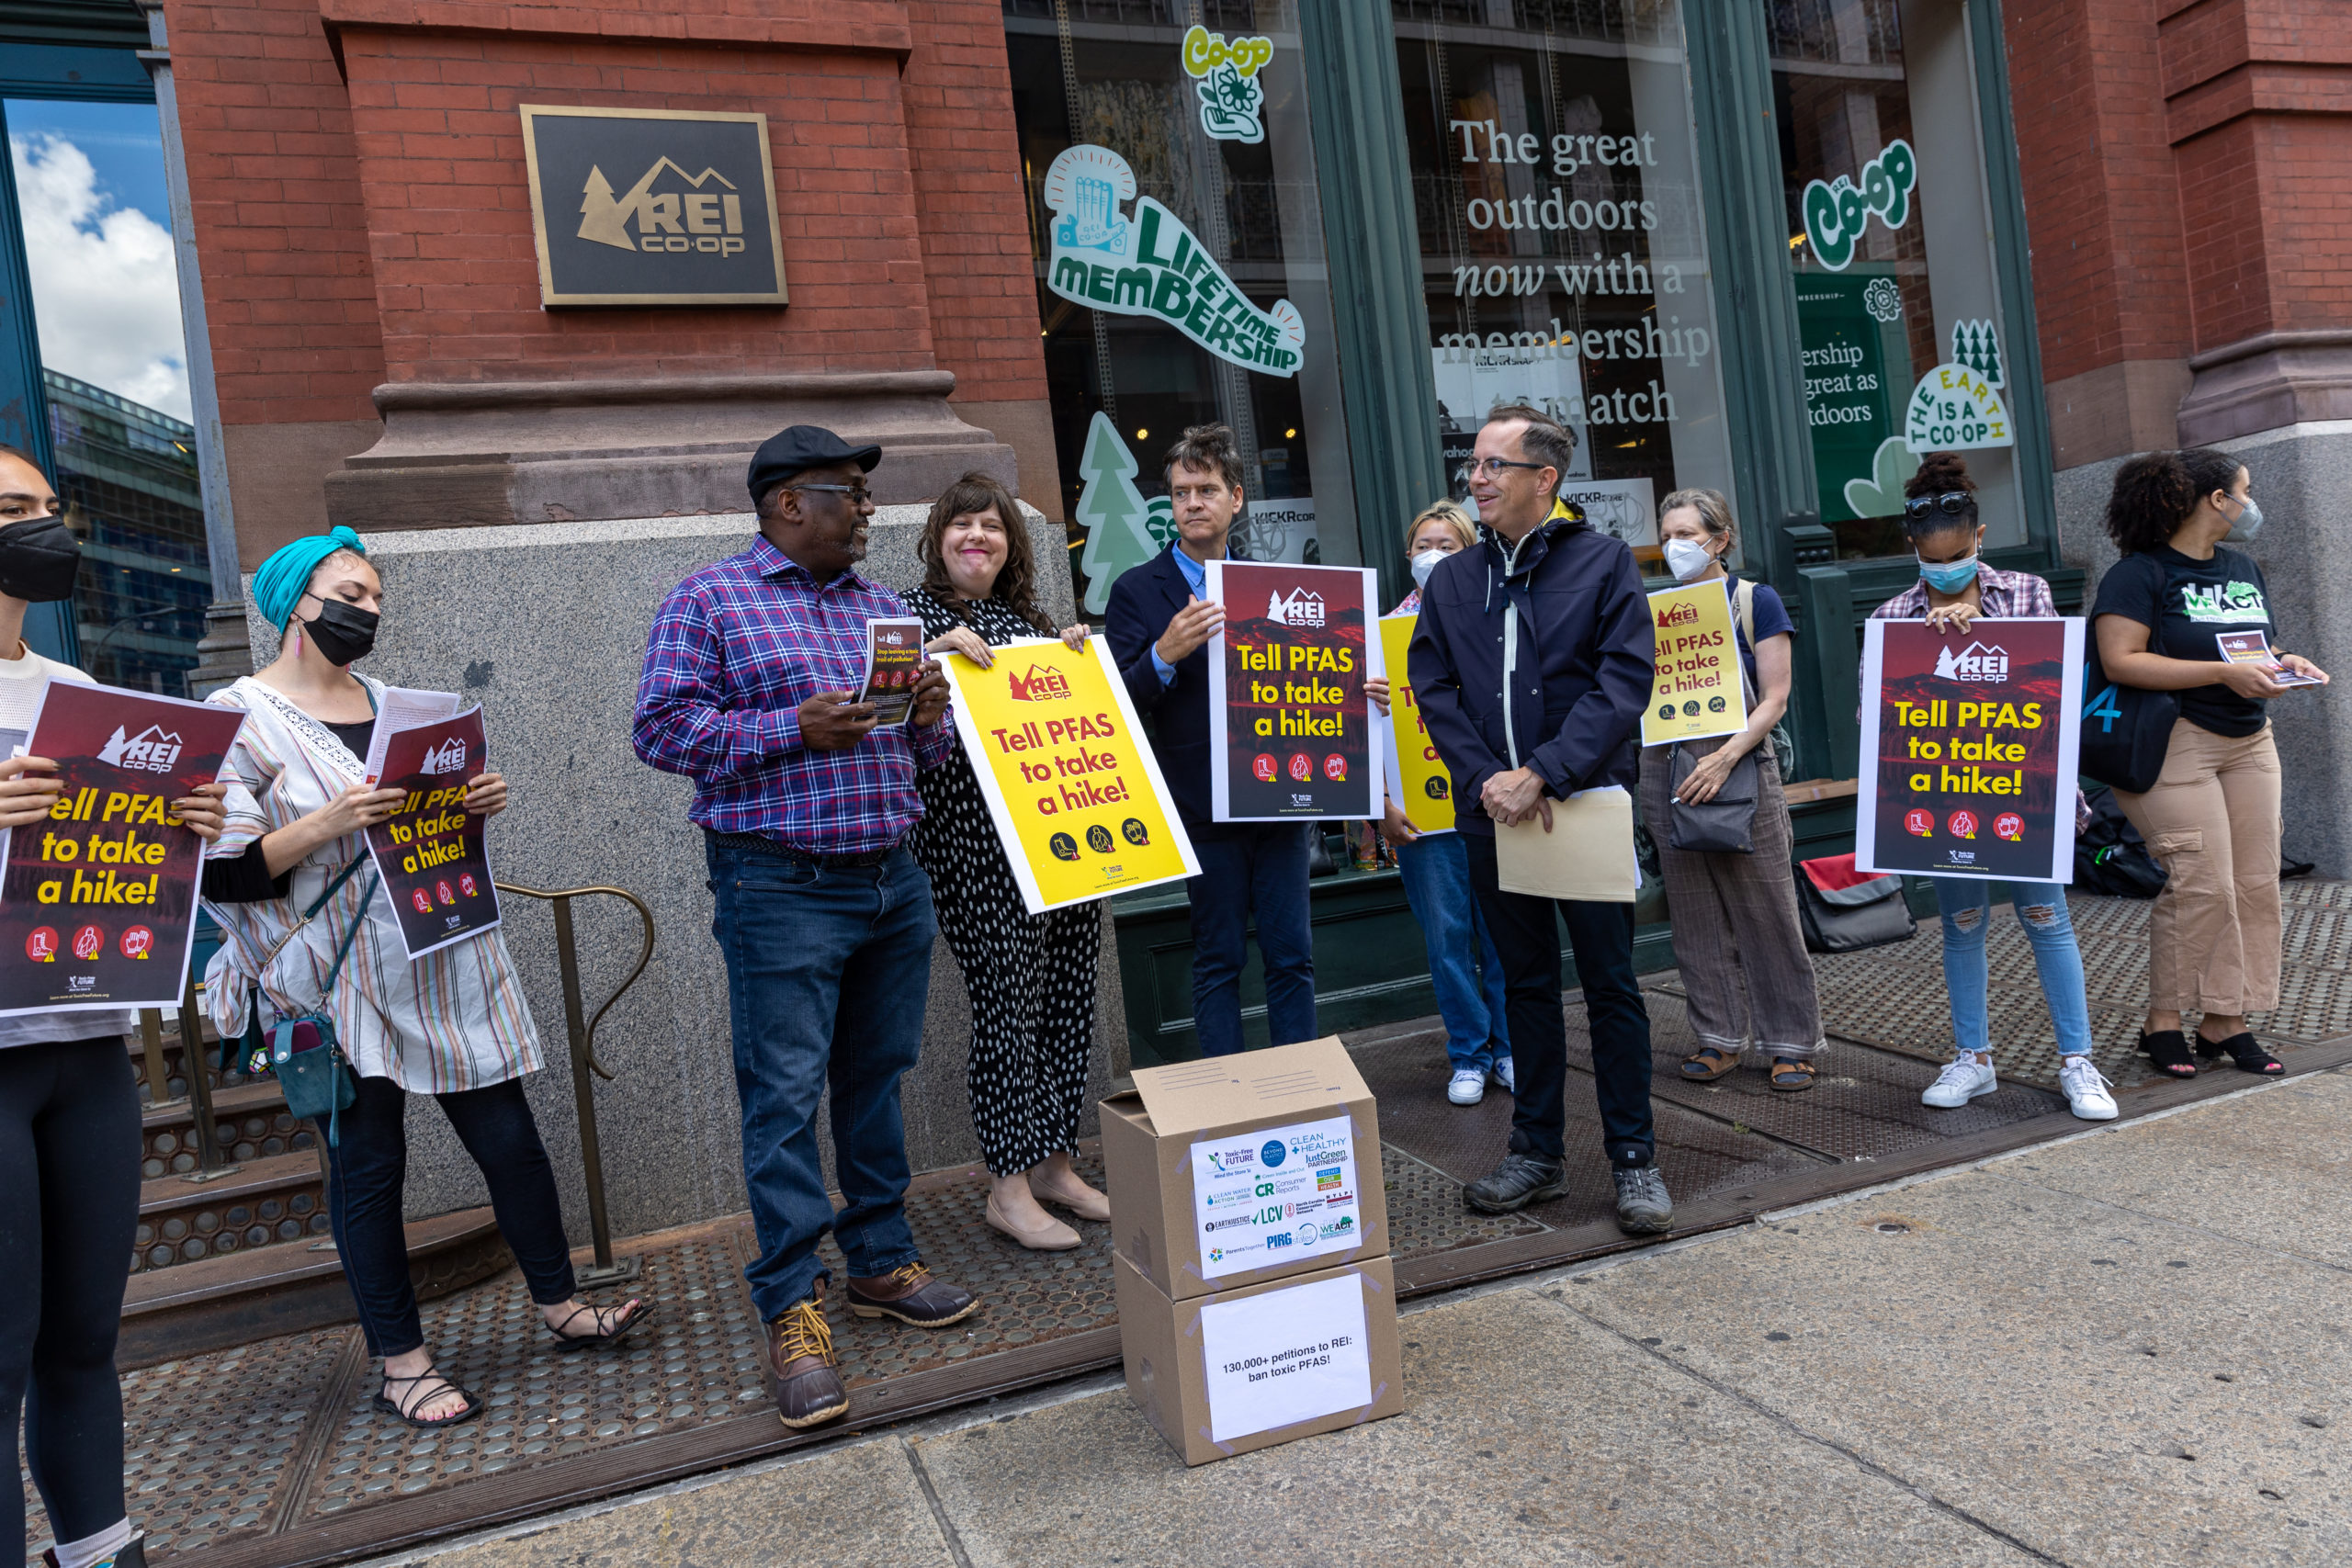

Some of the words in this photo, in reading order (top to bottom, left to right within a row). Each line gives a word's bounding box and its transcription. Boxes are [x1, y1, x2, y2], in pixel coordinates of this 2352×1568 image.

[1450, 118, 1541, 164] The
[1551, 130, 1658, 176] great
[638, 193, 743, 234] REI
[1467, 186, 1658, 231] outdoors
[1136, 205, 1281, 346] LIFETIME
[1453, 263, 1545, 297] now
[1555, 252, 1653, 295] with
[1662, 263, 1686, 293] a
[1439, 315, 1711, 367] membership
[1801, 341, 1864, 367] ership
[1856, 373, 1878, 390] as
[1545, 379, 1679, 427] match
[1911, 386, 1936, 444] THE
[1938, 401, 1957, 422] IS
[1962, 400, 1976, 420] A
[1939, 369, 2006, 438] EARTH
[1288, 601, 1325, 619] REI
[1671, 608, 1699, 623] REI
[1677, 629, 1724, 653] PFAS
[1237, 643, 1282, 671] Tell
[1289, 646, 1353, 673] PFAS
[1656, 660, 1673, 676] to
[1677, 652, 1719, 672] take
[1960, 656, 2008, 674] REI
[1031, 674, 1069, 694] REI
[1250, 680, 1279, 705] to
[1284, 676, 1344, 705] take
[1659, 682, 1671, 695] a
[1675, 671, 1722, 693] hike!
[1254, 717, 1272, 737] a
[1280, 708, 1344, 737] hike!
[1894, 699, 1948, 728] Tell
[1958, 702, 2042, 729] PFAS
[990, 721, 1044, 754] Tell
[1045, 713, 1115, 746] PFAS
[1908, 736, 1942, 760] to
[1949, 733, 2026, 761] take
[127, 739, 182, 762] REI
[437, 746, 467, 769] REI
[1019, 761, 1052, 784] to
[1054, 747, 1118, 778] take
[1909, 773, 1930, 792] a
[1940, 764, 2022, 795] hike!
[42, 787, 99, 820] ell
[424, 784, 468, 809] PFA
[1037, 795, 1059, 817] a
[1058, 775, 1131, 811] hike!
[390, 823, 413, 845] to
[415, 810, 467, 838] take
[41, 831, 81, 862] to
[87, 829, 165, 865] take
[402, 852, 420, 876] a
[419, 835, 466, 870] hike!
[37, 879, 62, 904] a
[70, 868, 158, 905] hike!
[1290, 1132, 1324, 1145] CLEAN
[1301, 1137, 1347, 1153] HEALTHY
[1225, 1148, 1253, 1158] Toxic-Free
[1226, 1155, 1254, 1166] FUTURE
[1306, 1149, 1346, 1164] JustGreen
[1307, 1156, 1348, 1168] PARTNERSHIP
[1318, 1168, 1339, 1177] DEFEND
[1255, 1182, 1275, 1198] CR
[1274, 1177, 1306, 1188] Consumer
[1275, 1185, 1300, 1195] Reports
[1261, 1204, 1283, 1225] LCV
[1267, 1232, 1293, 1249] PIRG
[1223, 1358, 1269, 1374] 130,000+
[1272, 1346, 1317, 1366] petitions
[1318, 1342, 1329, 1352] to
[1331, 1336, 1352, 1349] REI:
[1249, 1371, 1268, 1382] ban
[1271, 1363, 1296, 1378] toxic
[1298, 1355, 1330, 1371] PFAS!
